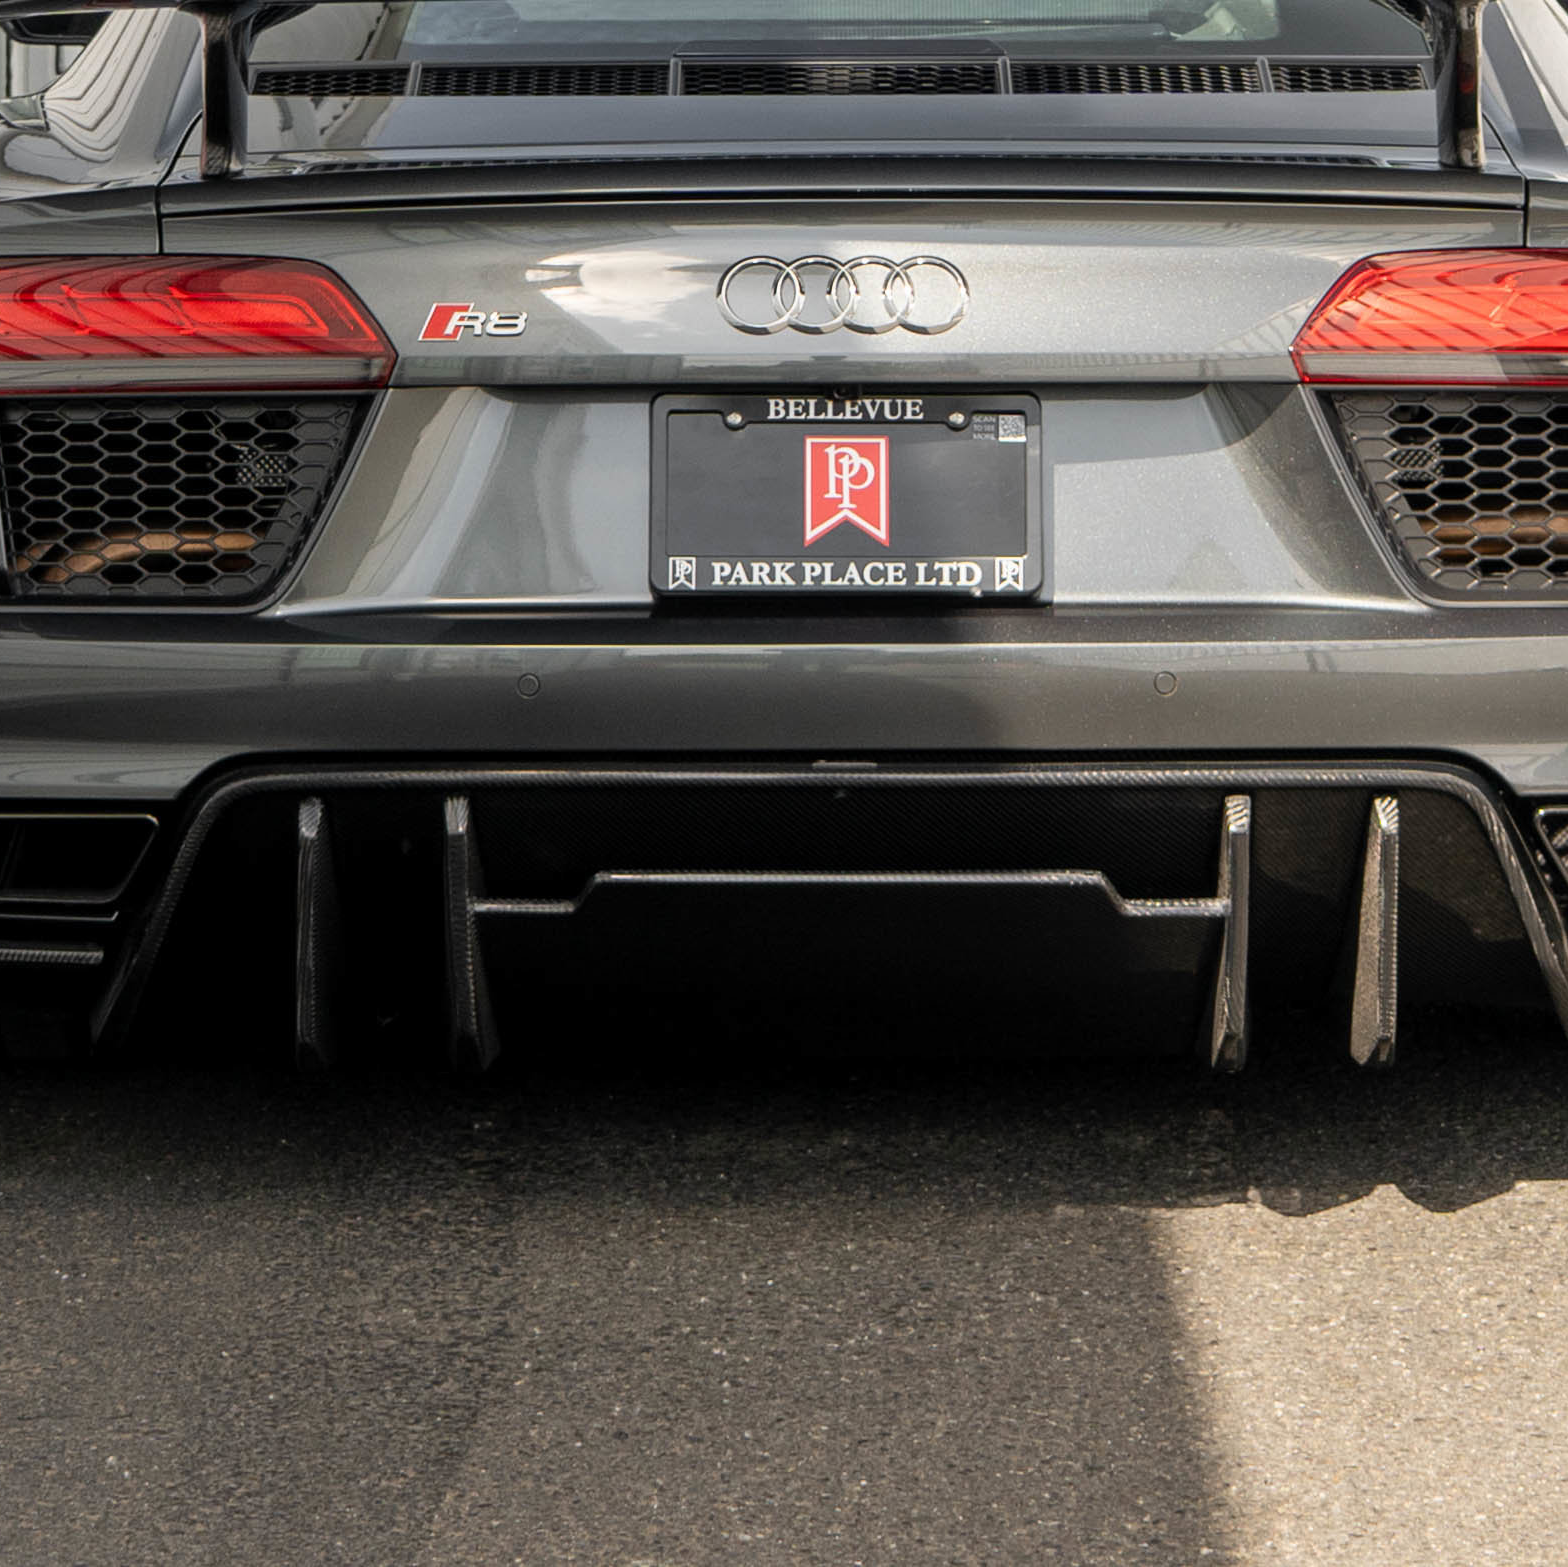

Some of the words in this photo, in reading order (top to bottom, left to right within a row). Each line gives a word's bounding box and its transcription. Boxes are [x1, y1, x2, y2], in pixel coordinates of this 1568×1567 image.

[444, 311, 529, 337] R8
[767, 398, 925, 421] BELLEVUE
[711, 561, 797, 586] PARK
[802, 560, 907, 587] PLACE
[915, 561, 983, 587] LTD
